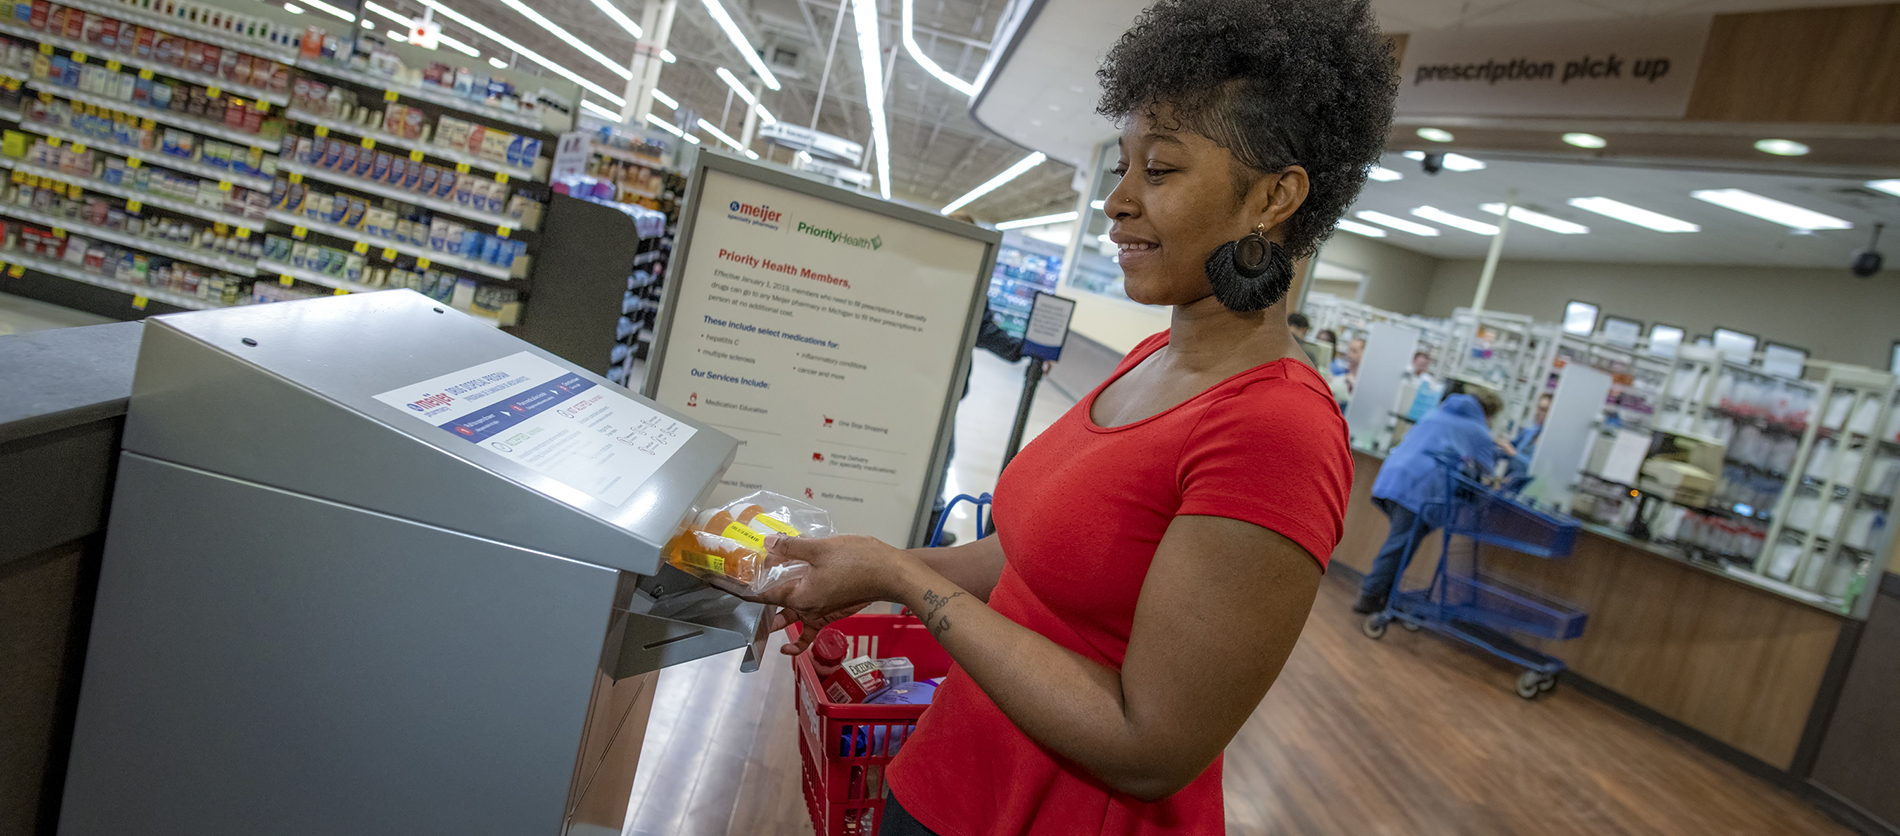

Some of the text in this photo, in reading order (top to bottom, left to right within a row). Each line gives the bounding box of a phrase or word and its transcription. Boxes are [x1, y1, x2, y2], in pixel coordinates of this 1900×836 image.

[1414, 54, 1670, 85] prescription pick up
[740, 202, 782, 222] meijer
[728, 213, 778, 231] specialty pharmacy
[718, 249, 851, 288] Priority Health Members,
[714, 269, 740, 281] Effective
[741, 276, 765, 287] January
[773, 283, 790, 292] 2019,
[792, 288, 819, 298] members
[861, 303, 895, 315] prescriptions
[904, 313, 927, 323] specialty
[708, 294, 730, 304] person
[748, 302, 779, 314] additional
[780, 309, 794, 318] cost.
[711, 282, 729, 291] drugs
[772, 294, 790, 304] Meijer
[791, 299, 820, 311] pharmacy
[828, 306, 854, 318] Michigan
[882, 319, 916, 332] prescriptions
[703, 315, 840, 350] These include select medications for:
[706, 334, 733, 345] hepatitis
[702, 349, 756, 364] multiple sclerosis
[801, 352, 867, 370] inflammatory conditions
[691, 368, 771, 389] Our Services Include:
[798, 367, 817, 377] cancer
[818, 370, 830, 379] and
[414, 370, 512, 410] meijer DRUG DISPOSAL PROGRAM
[424, 406, 452, 417] pharmacy
[570, 400, 594, 411] ACCEPTED
[705, 399, 768, 414] Medication Education
[851, 422, 863, 430] Stop
[864, 424, 889, 434] Shopping
[503, 432, 532, 447] ACCEPTED
[839, 462, 863, 470] specialty
[863, 465, 896, 475] medications)
[739, 480, 762, 490] Support
[835, 493, 864, 504] Reminders
